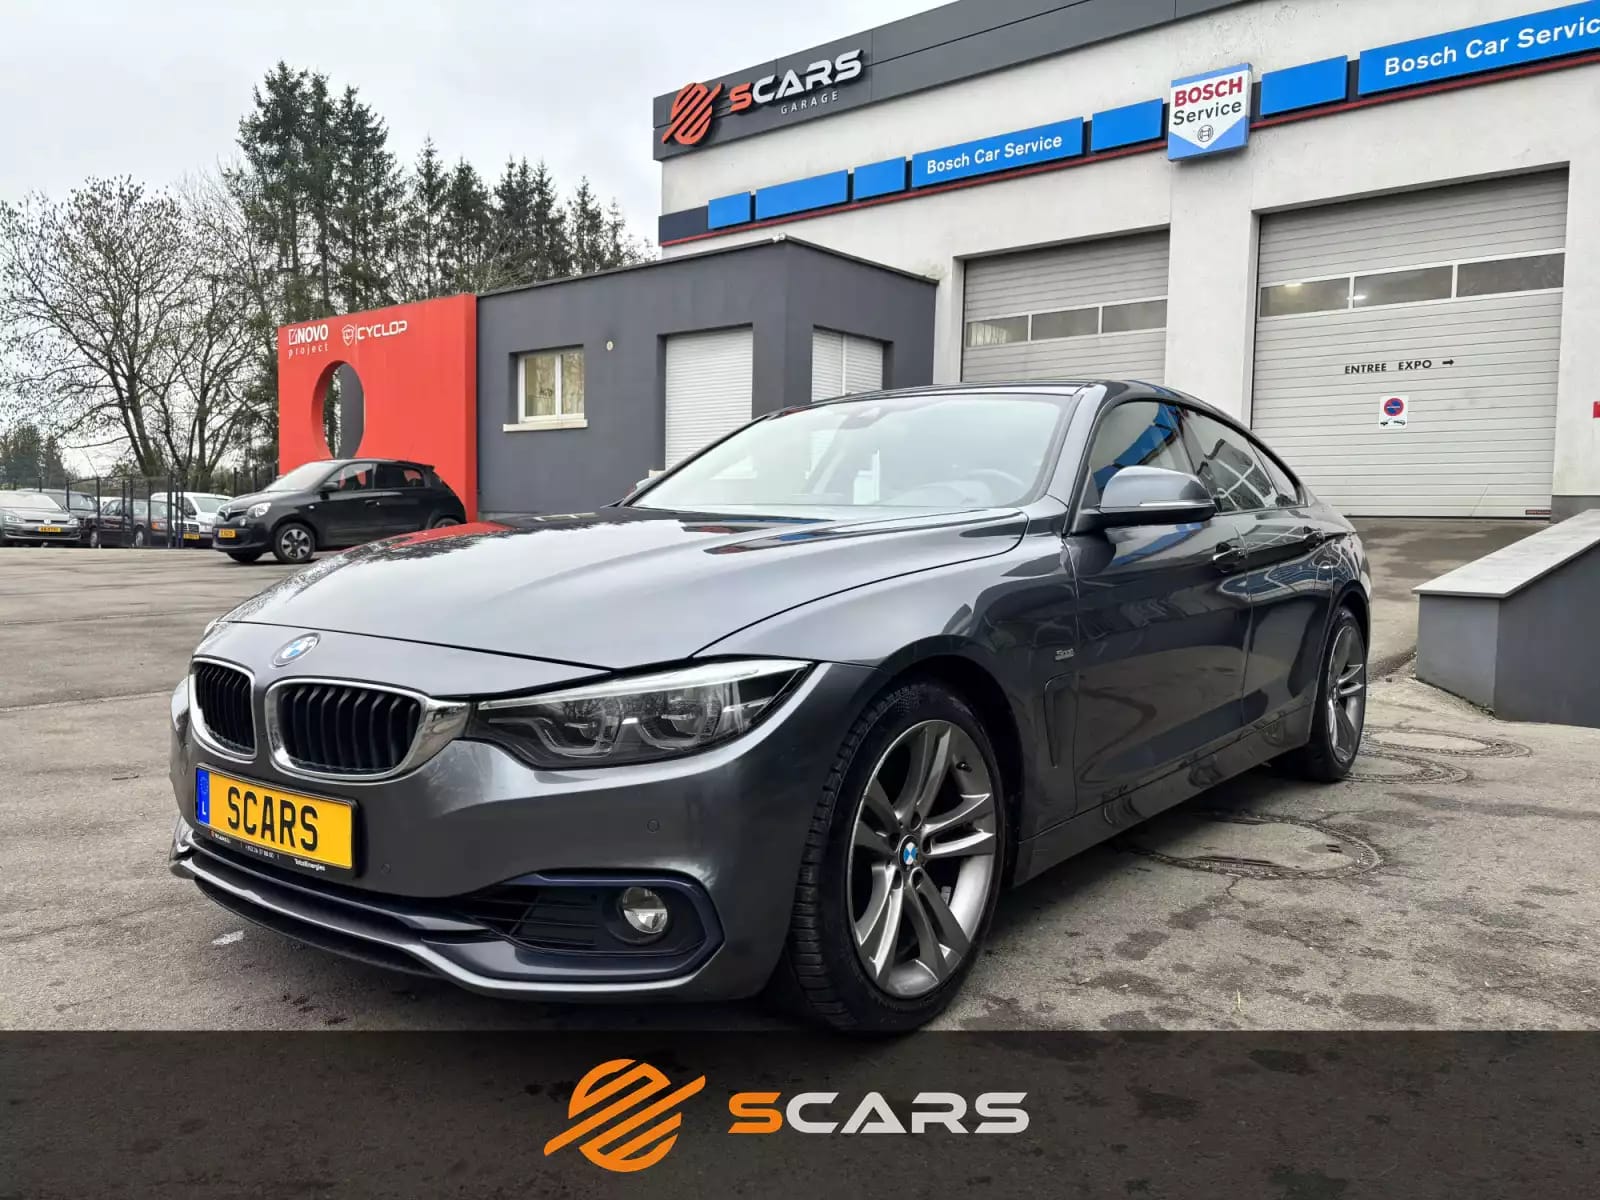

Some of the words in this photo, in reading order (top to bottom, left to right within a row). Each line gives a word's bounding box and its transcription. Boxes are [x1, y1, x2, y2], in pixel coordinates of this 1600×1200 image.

[1384, 46, 1458, 77] Bosch
[1465, 37, 1510, 59] Car
[729, 49, 863, 113] SCARS
[1174, 76, 1243, 107] BOSCH
[780, 91, 839, 114] GARAGE
[1172, 101, 1242, 126] Service
[926, 155, 970, 175] Bosch
[974, 148, 1000, 164] Car
[1004, 136, 1063, 158] Service
[357, 320, 408, 340] CYCLOP
[288, 343, 329, 359] project
[1344, 362, 1387, 375] ENTREE
[1398, 359, 1433, 371] EXPO
[201, 803, 207, 815] L
[227, 786, 318, 851] SCARS
